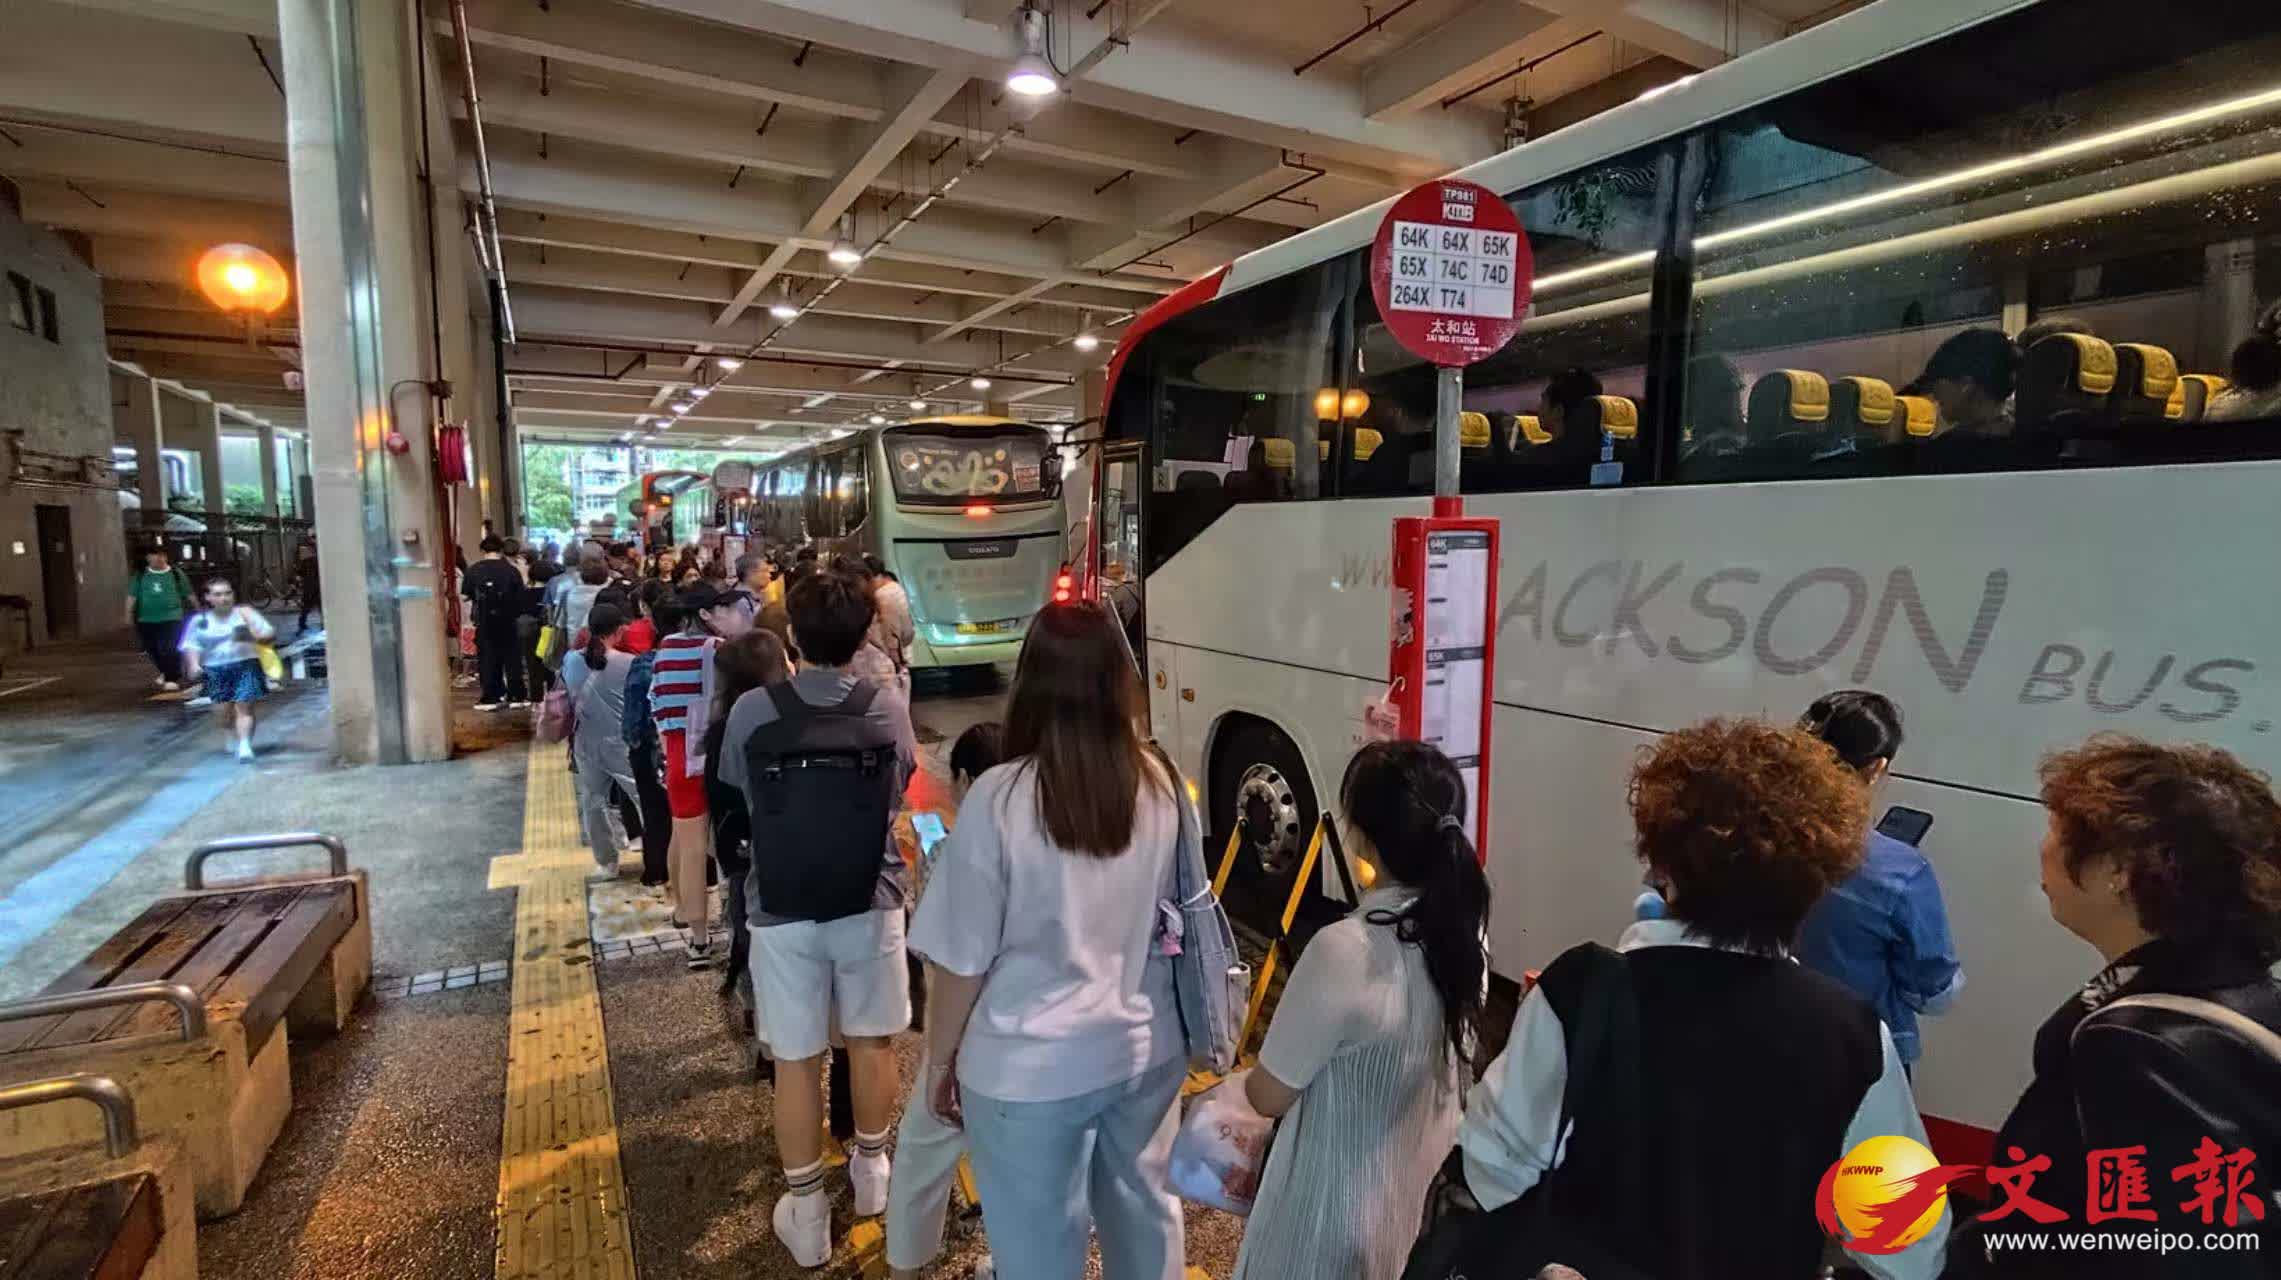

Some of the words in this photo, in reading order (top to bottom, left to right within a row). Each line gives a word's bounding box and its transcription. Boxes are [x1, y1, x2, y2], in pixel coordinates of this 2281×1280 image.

[1401, 226, 1429, 248] 64K
[1442, 231, 1470, 252] 64X
[1483, 235, 1510, 256] 65K
[1400, 256, 1427, 277] 65X
[1441, 259, 1468, 281] 74C
[1482, 263, 1508, 284] 74D
[1394, 284, 1430, 306] 264X
[1441, 288, 1466, 308] T74
[1430, 318, 1476, 336] 太和站
[1451, 336, 1479, 345] STATION
[1497, 558, 2007, 694] ACKSON
